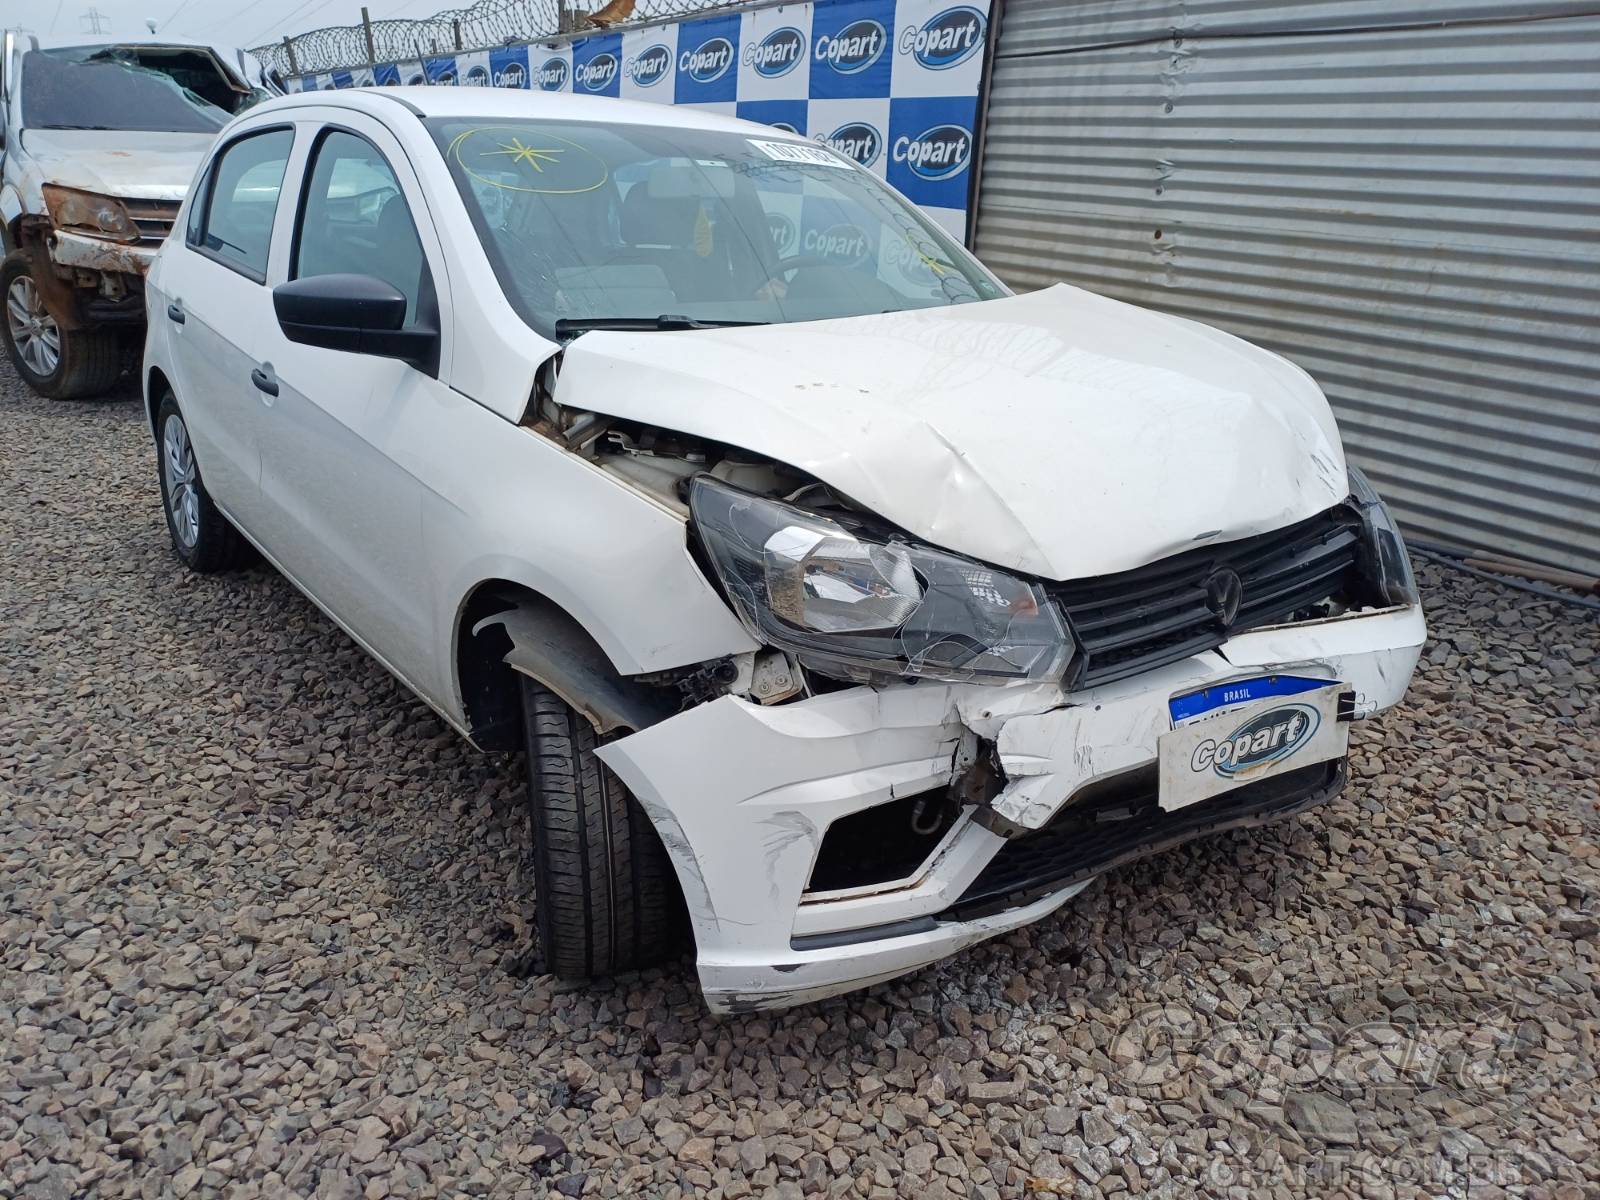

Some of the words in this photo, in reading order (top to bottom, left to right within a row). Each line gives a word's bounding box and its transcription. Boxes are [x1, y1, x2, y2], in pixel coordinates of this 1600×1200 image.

[815, 30, 878, 65] Copart
[899, 17, 977, 58] Copart
[624, 46, 669, 77] Copart
[679, 44, 728, 75] Copart
[743, 36, 798, 70] Copart
[493, 67, 523, 87] Copart
[533, 60, 565, 84] Copart
[575, 58, 615, 83] Copart
[893, 138, 966, 164] Copart
[804, 229, 865, 256] Copart
[1223, 688, 1252, 702] BRASIL
[1191, 711, 1306, 772] Copart
